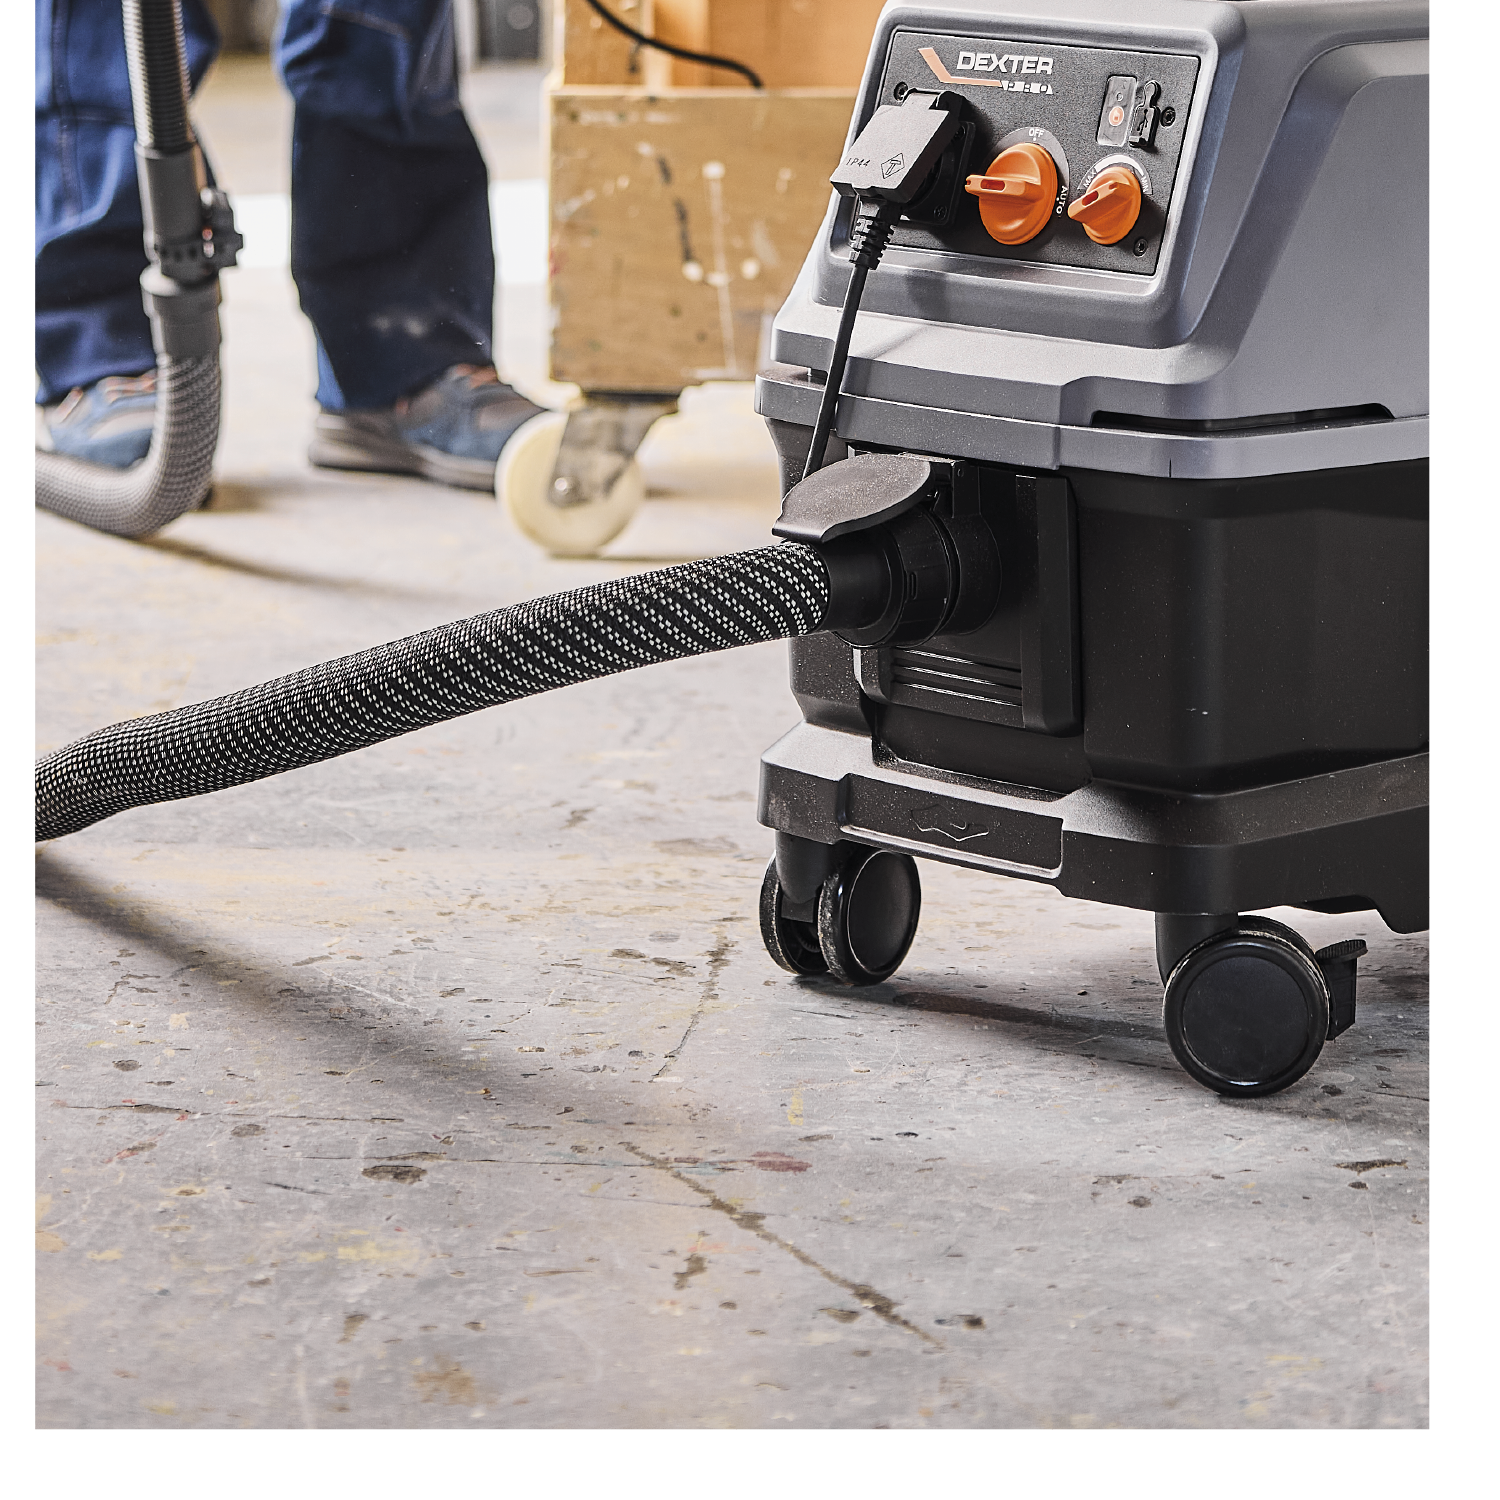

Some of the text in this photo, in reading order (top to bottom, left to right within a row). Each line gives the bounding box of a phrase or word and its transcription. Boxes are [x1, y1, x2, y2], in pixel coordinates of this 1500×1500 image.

[957, 51, 1054, 74] DEXTER
[1003, 81, 1051, 94] PRO
[1028, 128, 1045, 138] OFF
[846, 157, 871, 168] IP44
[1083, 169, 1097, 189] MAX
[1141, 176, 1150, 194] MIN
[1056, 185, 1069, 214] AUTO
